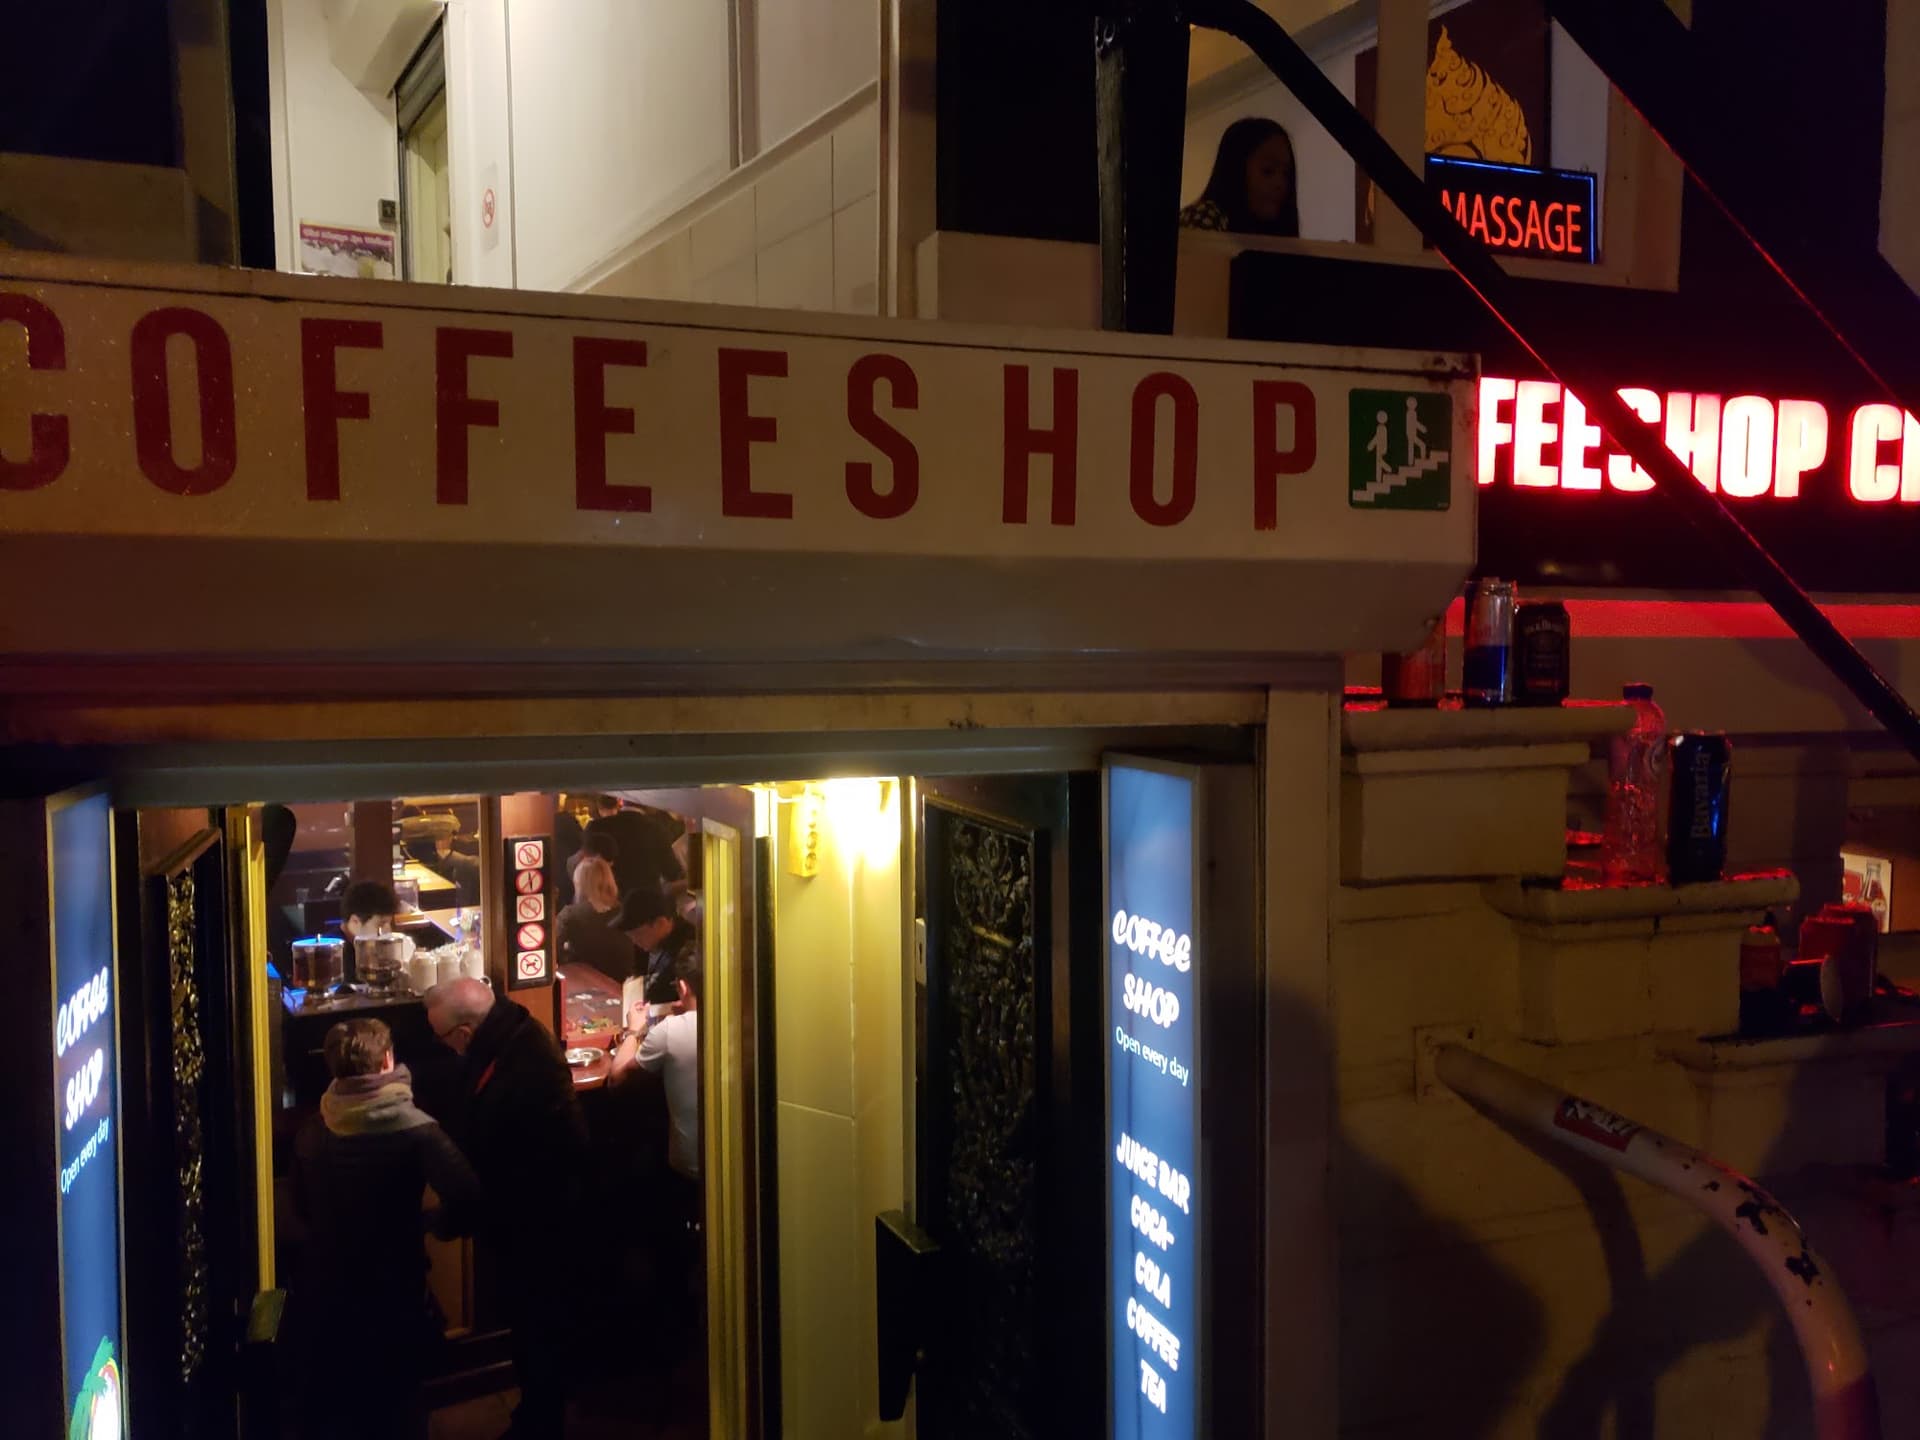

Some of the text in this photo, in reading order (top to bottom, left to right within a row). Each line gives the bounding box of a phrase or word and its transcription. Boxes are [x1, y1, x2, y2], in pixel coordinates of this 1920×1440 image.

[1442, 189, 1582, 253] MASSAGE
[1123, 973, 1179, 1028] SHOP
[1115, 1026, 1189, 1086] Open every day
[65, 1048, 103, 1131] SHOP
[61, 1117, 109, 1194] Open every day
[1116, 1132, 1190, 1214] JUICE BAR
[1135, 1252, 1170, 1309] COLA
[1127, 1297, 1180, 1371] COFFEE
[1140, 1359, 1166, 1414] TEA
